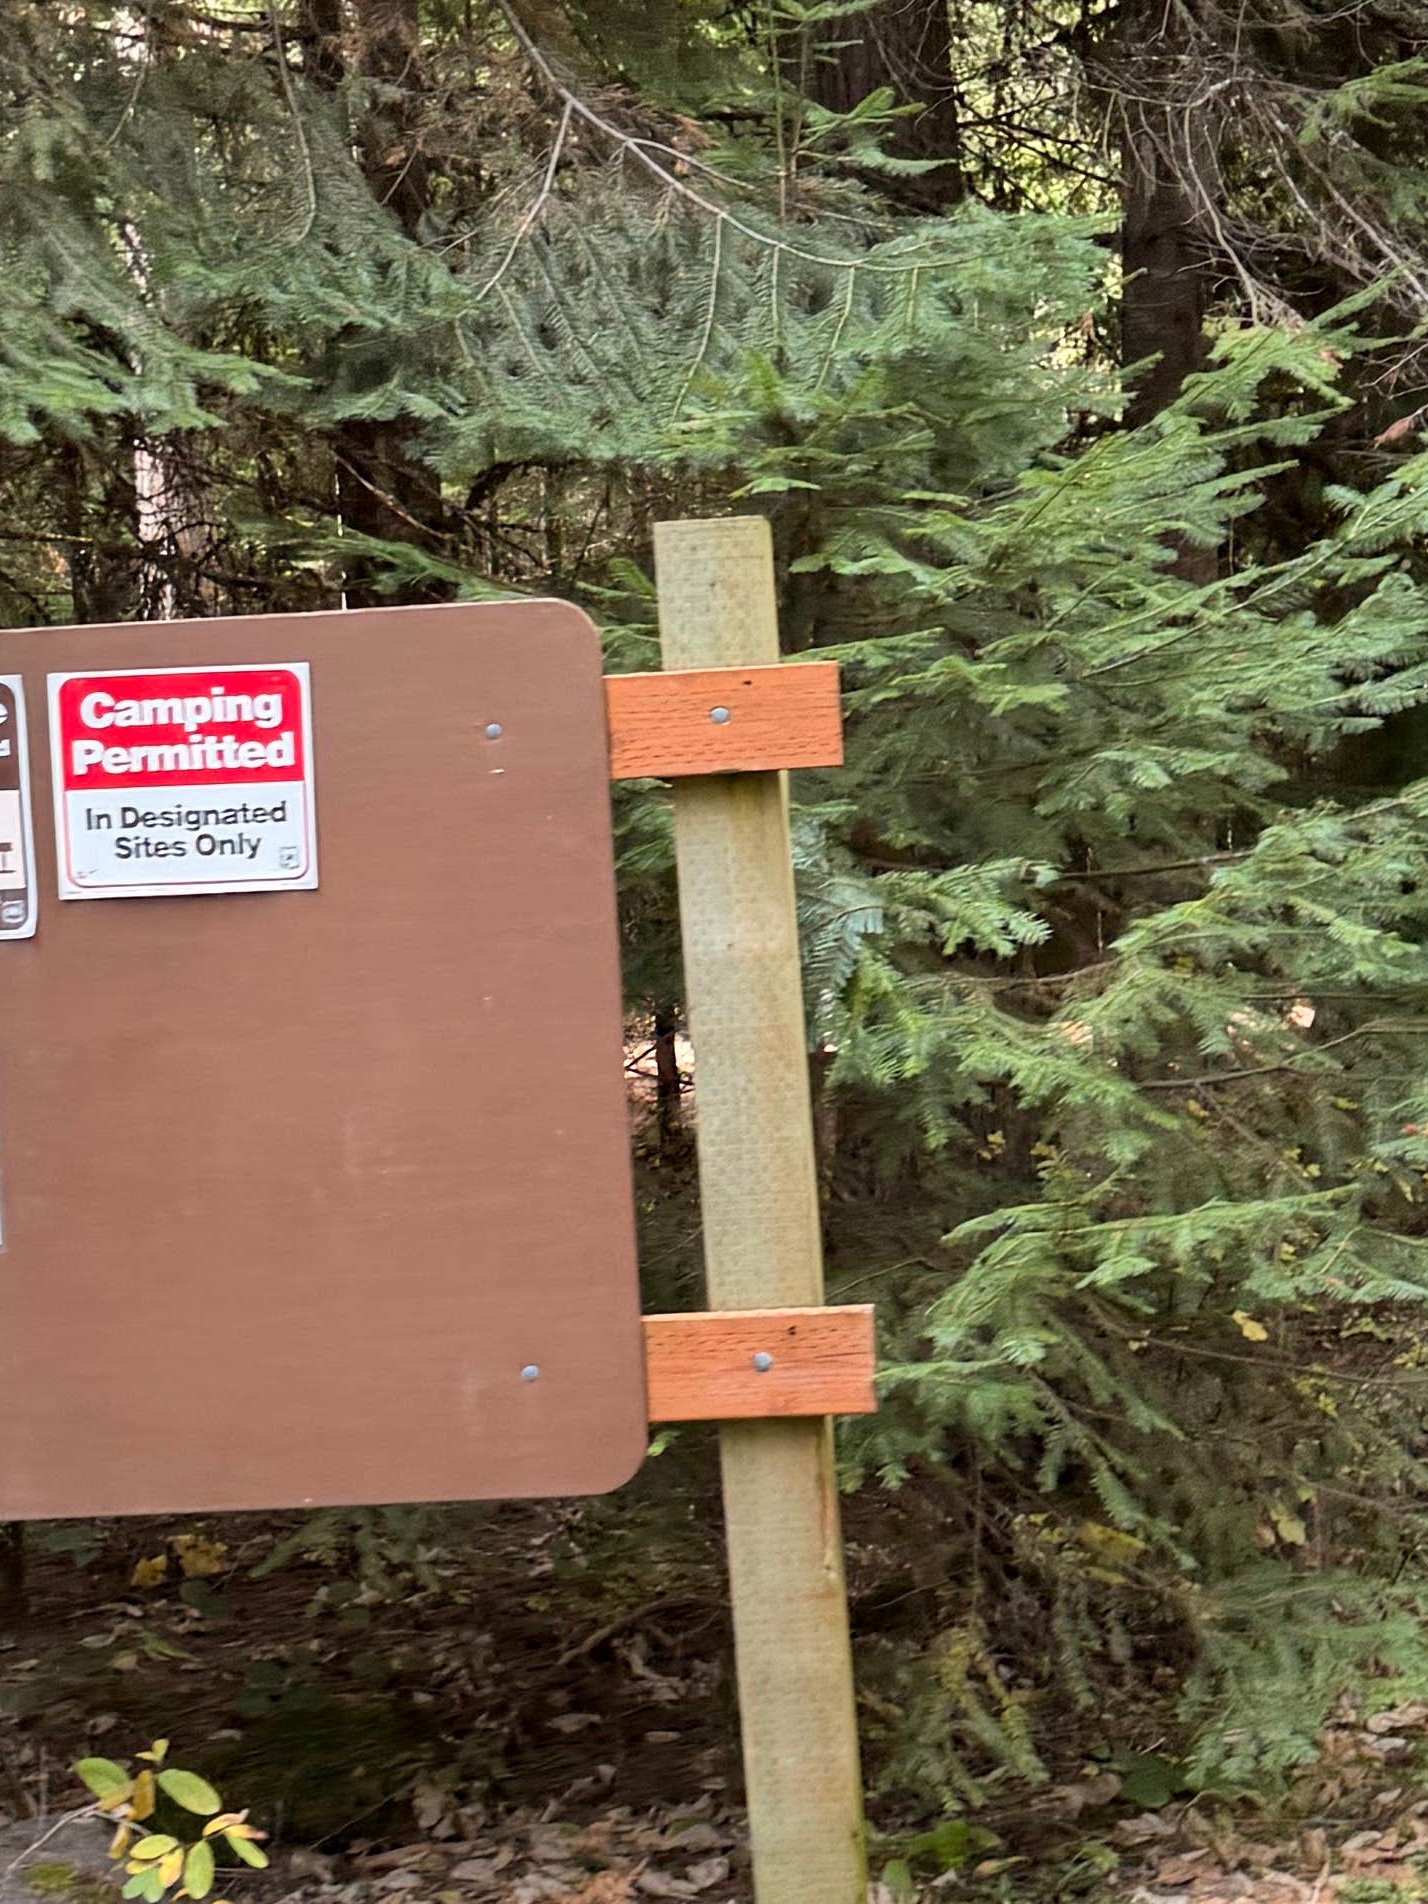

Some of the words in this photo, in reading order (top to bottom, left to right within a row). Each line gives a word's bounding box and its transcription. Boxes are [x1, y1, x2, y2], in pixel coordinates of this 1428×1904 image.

[80, 686, 283, 732] Camping
[72, 732, 295, 775] Permitted
[86, 808, 112, 830] In
[121, 801, 287, 831] Designated
[115, 836, 187, 860] Sites
[195, 833, 262, 859] Only
